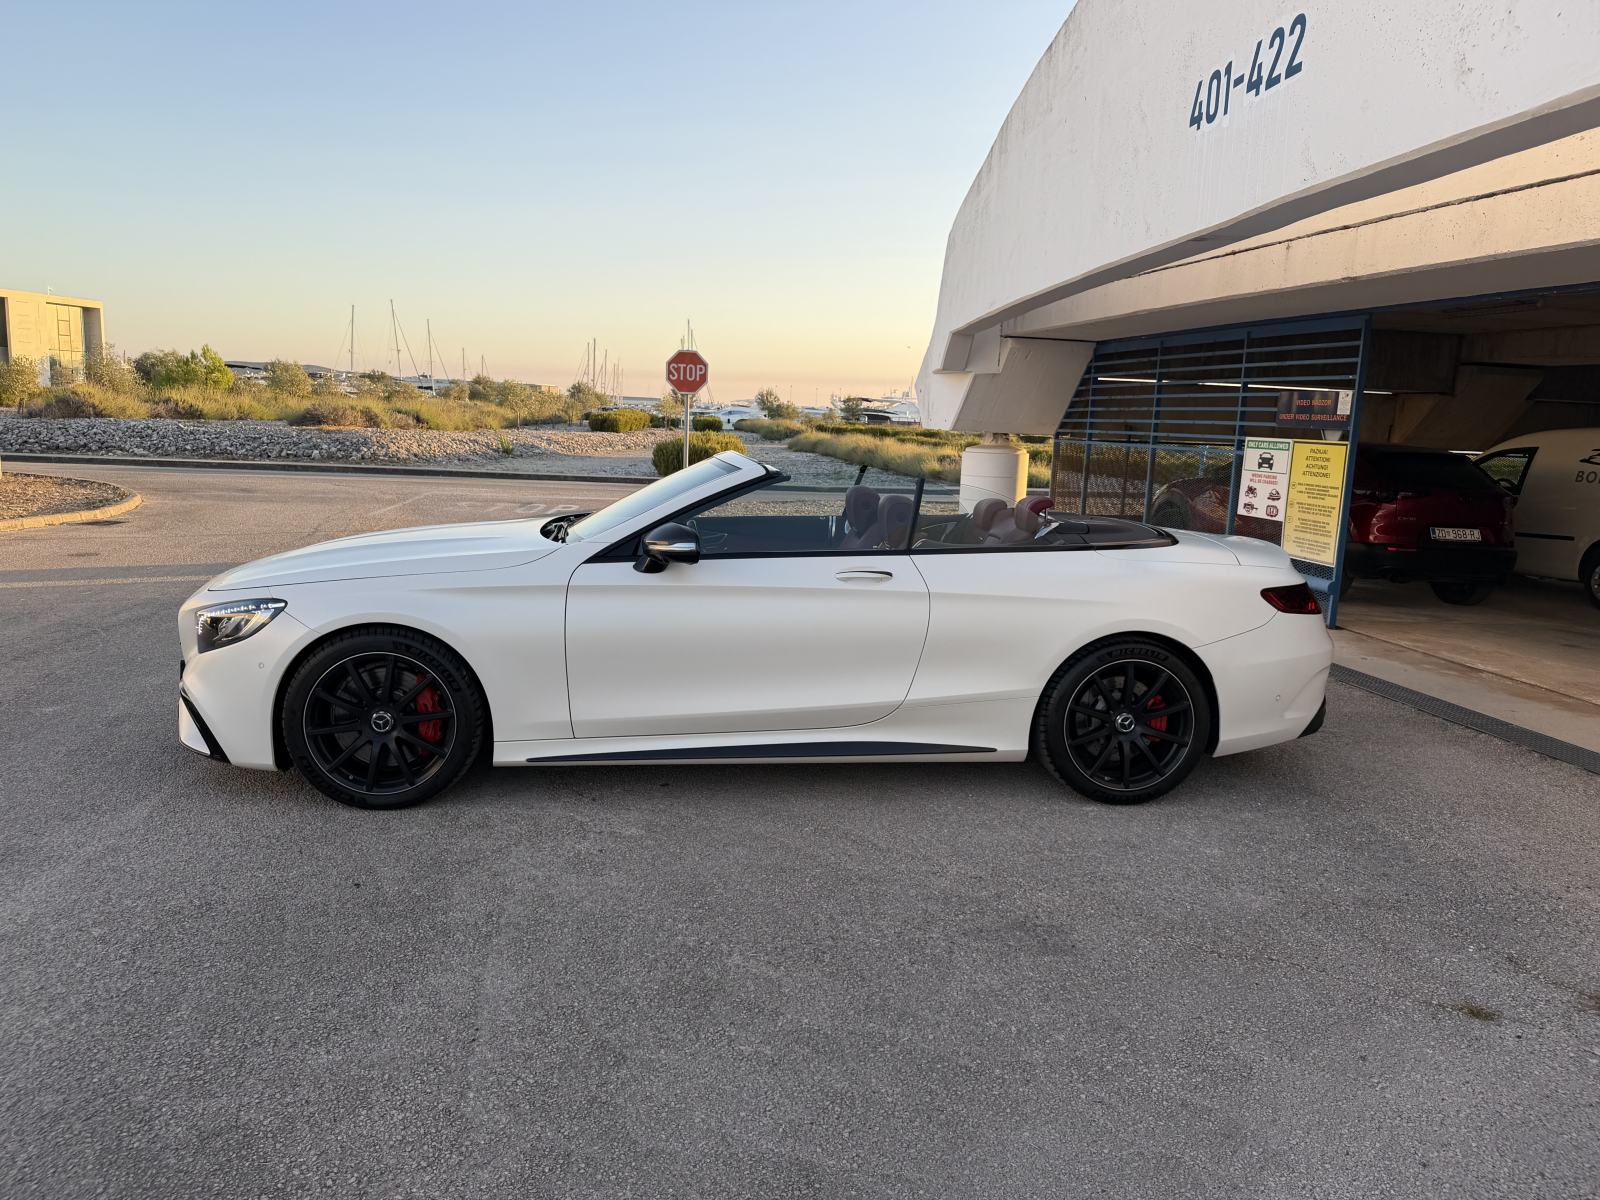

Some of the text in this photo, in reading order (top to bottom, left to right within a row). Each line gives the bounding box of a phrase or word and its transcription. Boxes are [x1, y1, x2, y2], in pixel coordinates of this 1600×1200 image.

[1189, 13, 1307, 131] 401-422
[668, 363, 706, 382] STOP
[1311, 414, 1347, 422] SURVEILLANCE
[1268, 442, 1289, 450] ALLOWED
[1306, 463, 1329, 471] ACHTUNG!
[1302, 471, 1331, 479] ATTENZIONE!
[1575, 470, 1600, 484] BO
